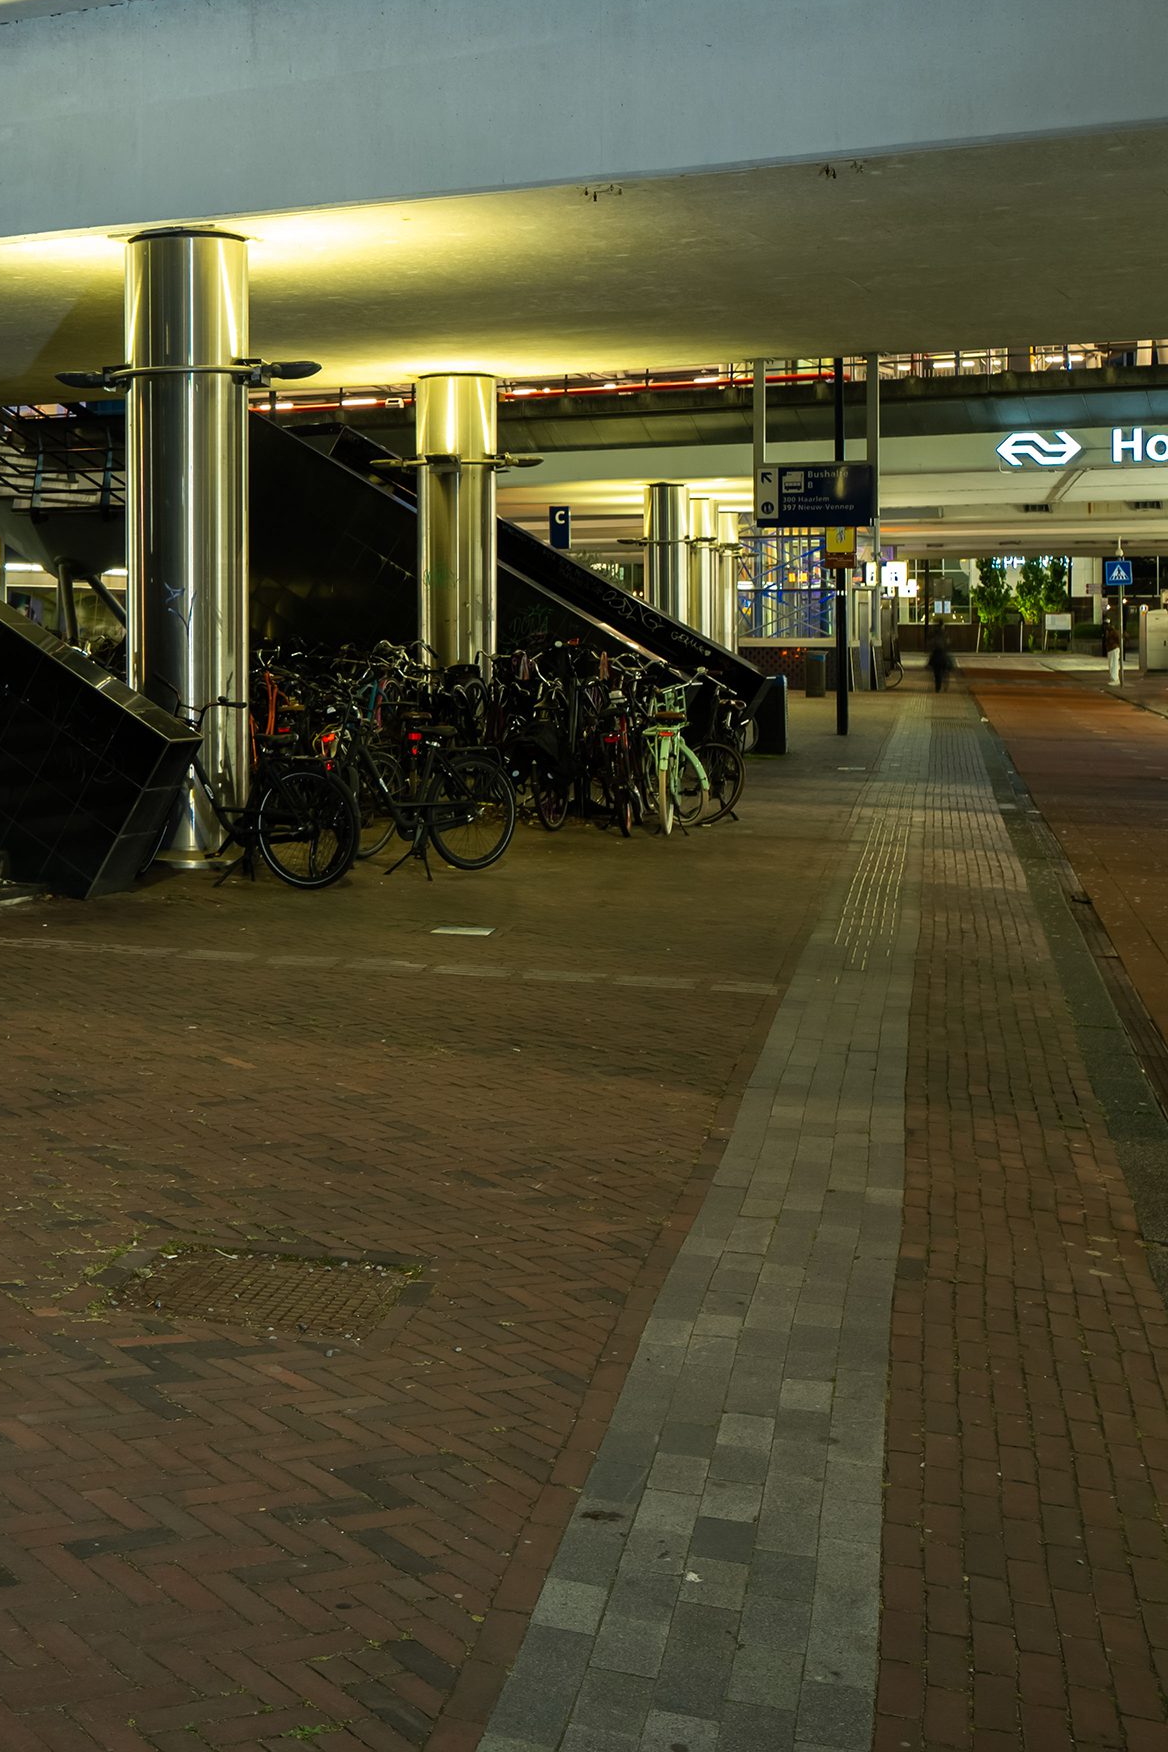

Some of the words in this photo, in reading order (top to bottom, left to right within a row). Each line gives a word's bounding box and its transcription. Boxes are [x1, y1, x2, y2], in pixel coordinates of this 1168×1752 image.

[807, 469, 849, 479] Bushalte
[798, 495, 830, 503] Haarlem
[782, 504, 796, 512] 397
[554, 510, 566, 525] C
